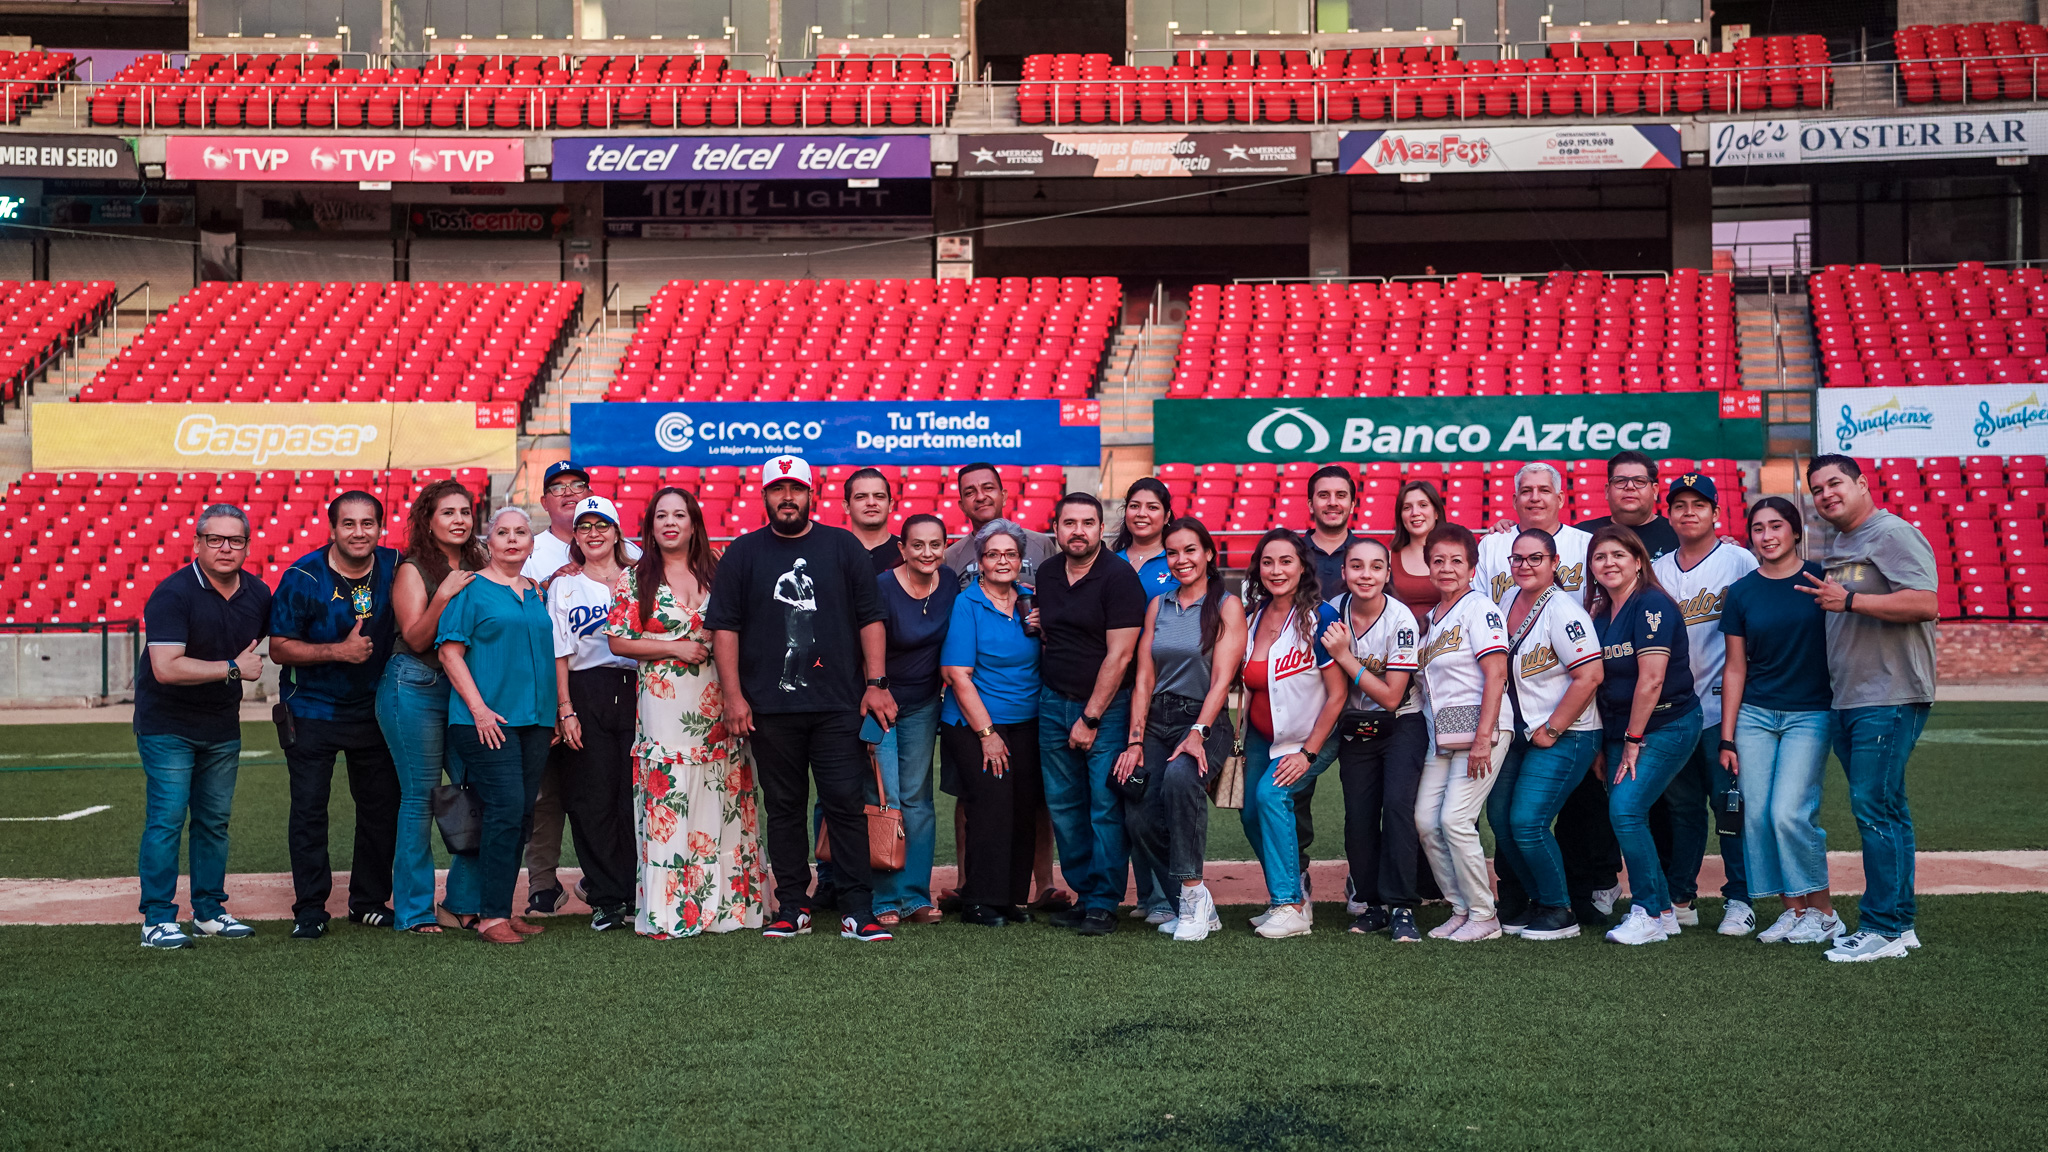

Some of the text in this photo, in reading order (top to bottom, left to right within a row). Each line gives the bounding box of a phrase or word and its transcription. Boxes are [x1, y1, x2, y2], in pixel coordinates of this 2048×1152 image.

[1715, 121, 1789, 165] Joe's
[1800, 119, 2027, 151] OYSTER BAR
[40, 147, 64, 166] EN
[66, 148, 118, 168] SERIO
[232, 149, 289, 172] TVP
[340, 149, 396, 172] TVP
[586, 142, 890, 171] telcel telcel telcel
[995, 149, 1043, 157] AMERICAN
[1051, 140, 1196, 159] Los mejores Gimnasios
[1248, 146, 1296, 154] AMERICAN
[1375, 135, 1490, 167] MazFest
[1727, 152, 1786, 161] OYSTER BAR
[438, 150, 495, 172] TVP
[1130, 157, 1167, 174] mejor
[1169, 155, 1210, 174] precio
[642, 183, 890, 216] TECATE LIGHT
[887, 411, 990, 430] Tu Tienda
[1974, 401, 2048, 448] Sinaloe
[174, 413, 364, 465] Gaspasa
[857, 429, 1022, 453] Departamental
[1340, 415, 1672, 453] Banco Azteca
[708, 444, 803, 456] Lo Mejor Para Vivir Bien
[1535, 586, 1557, 607] BIMBA
[1601, 641, 1634, 660] DOS
